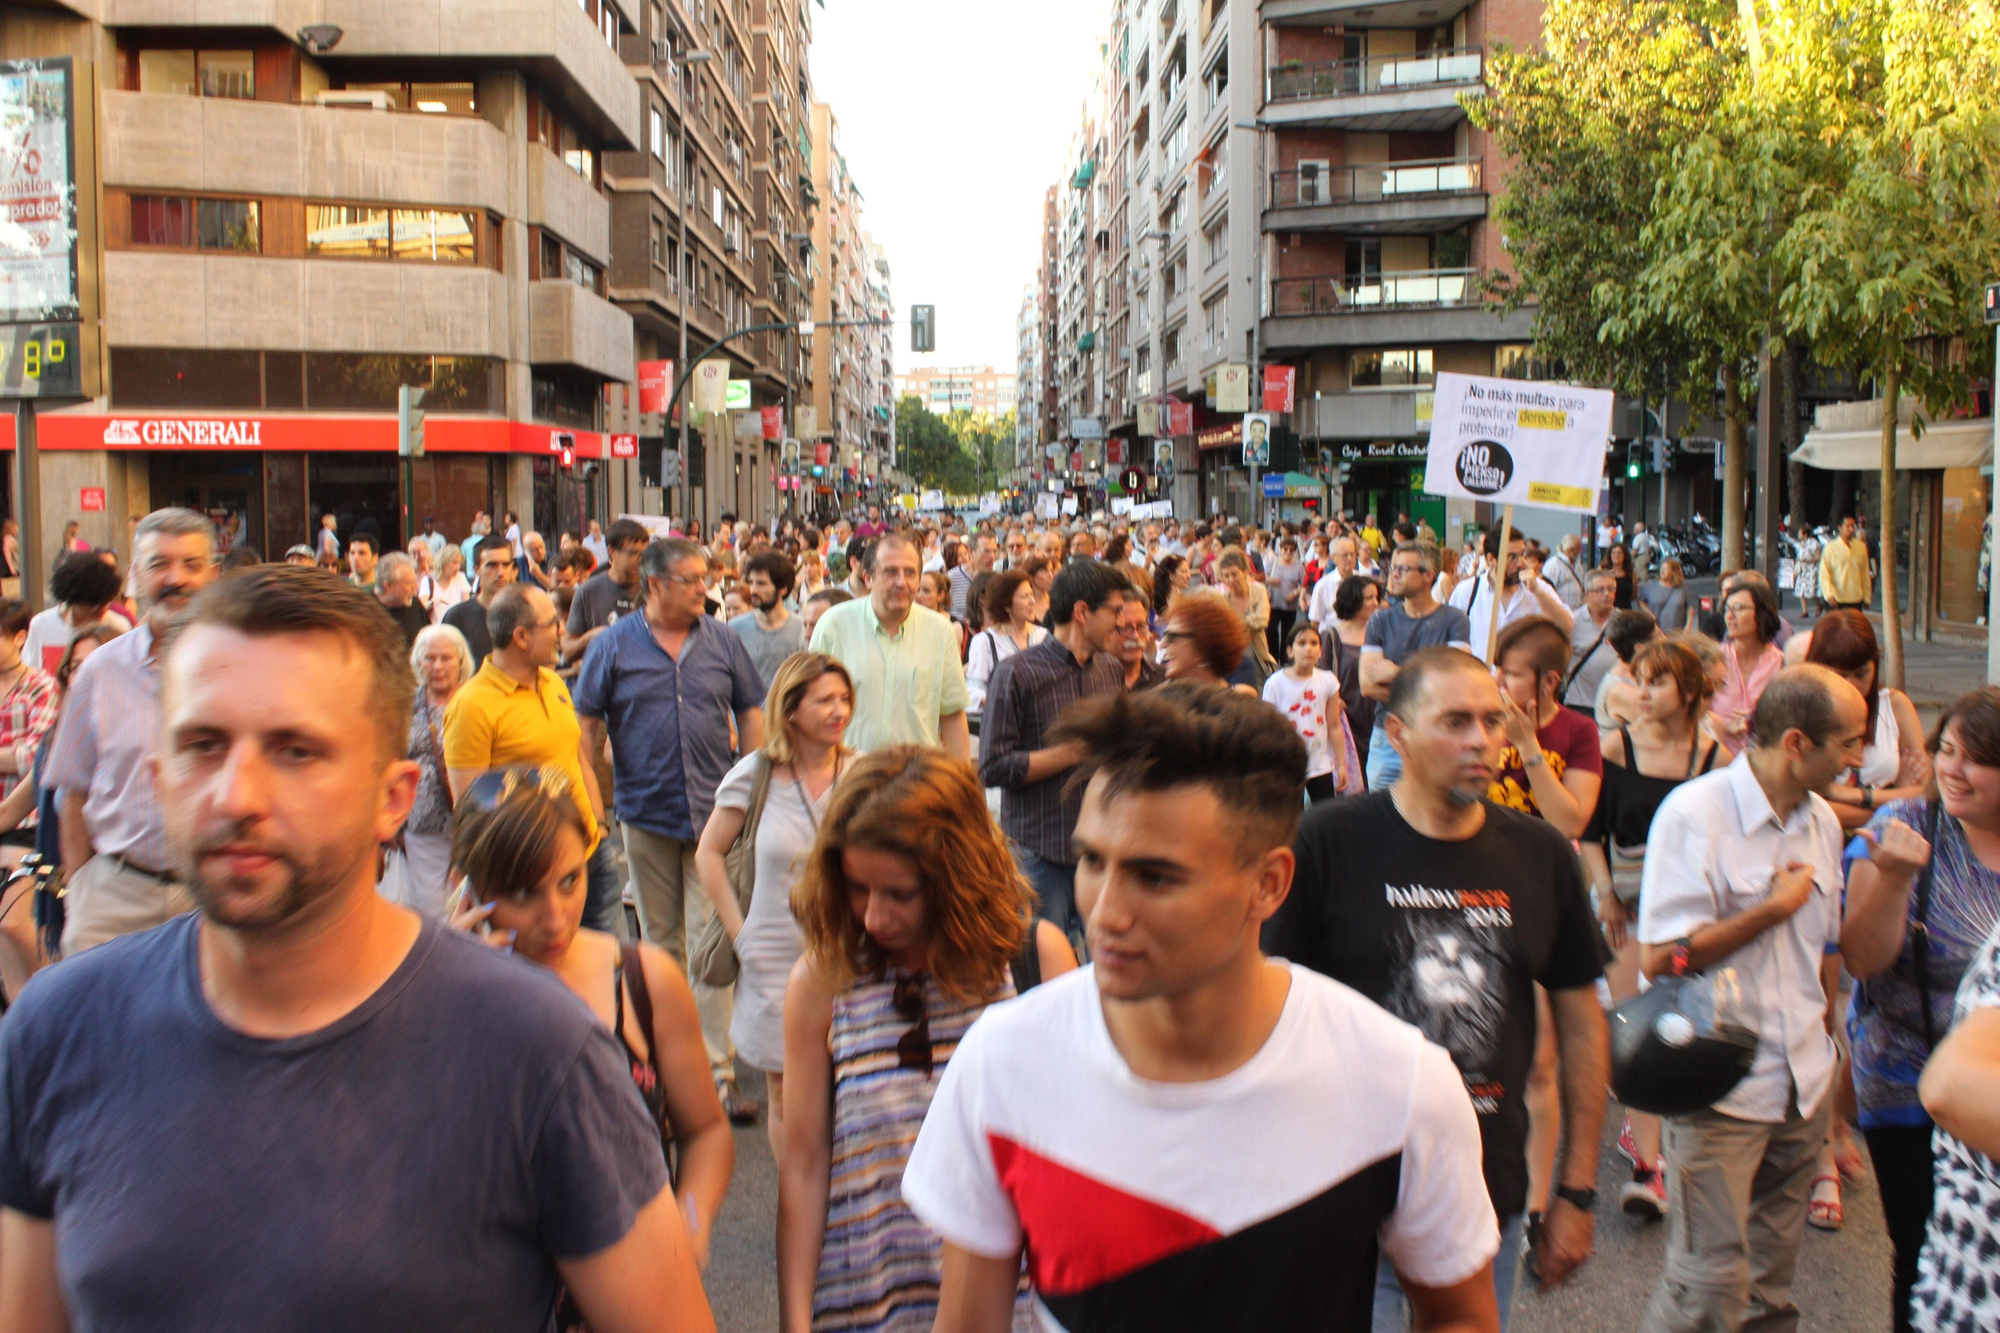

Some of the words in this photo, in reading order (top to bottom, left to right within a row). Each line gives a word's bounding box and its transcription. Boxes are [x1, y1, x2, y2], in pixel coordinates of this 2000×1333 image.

[1487, 387, 1513, 403] más
[1515, 391, 1556, 408] multas
[1558, 397, 1585, 412] para
[1461, 402, 1506, 420] impedir
[1506, 407, 1517, 422] el
[1519, 409, 1566, 427] derecho
[1567, 417, 1575, 429] a
[142, 420, 262, 446] GENERALI
[1458, 421, 1514, 439] protestar!
[1342, 443, 1362, 461] Caja
[1368, 442, 1396, 456] Rural
[1464, 464, 1500, 482] PIENSO
